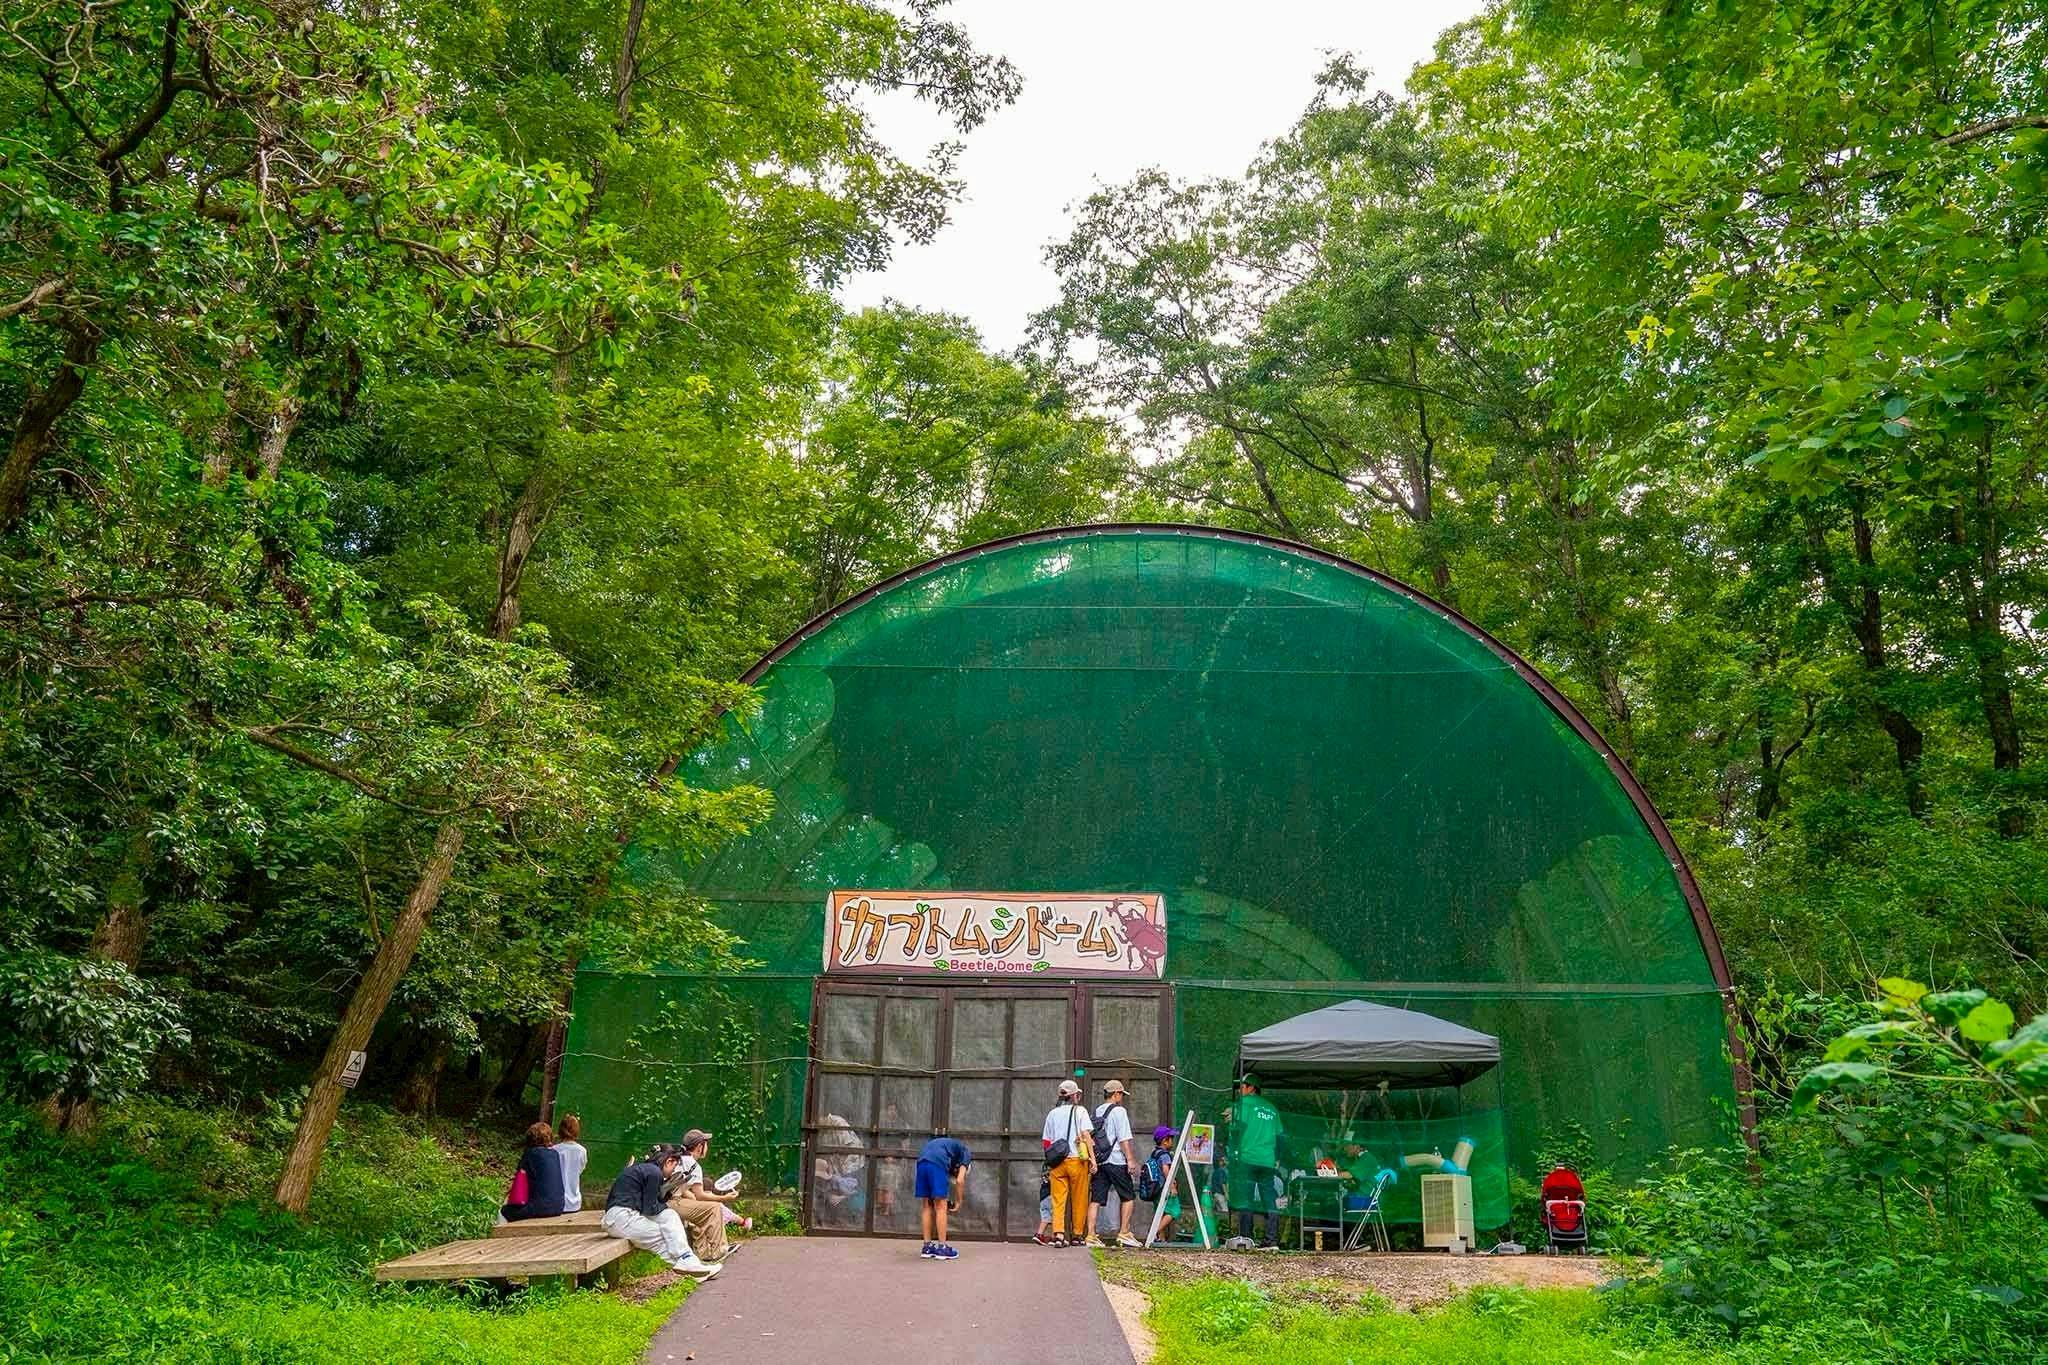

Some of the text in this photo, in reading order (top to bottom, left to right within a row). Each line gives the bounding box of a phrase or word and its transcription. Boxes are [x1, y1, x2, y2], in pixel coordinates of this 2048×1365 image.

[841, 898, 1117, 962] カブトムシドーム
[950, 959, 1033, 972] Beetle Dome
